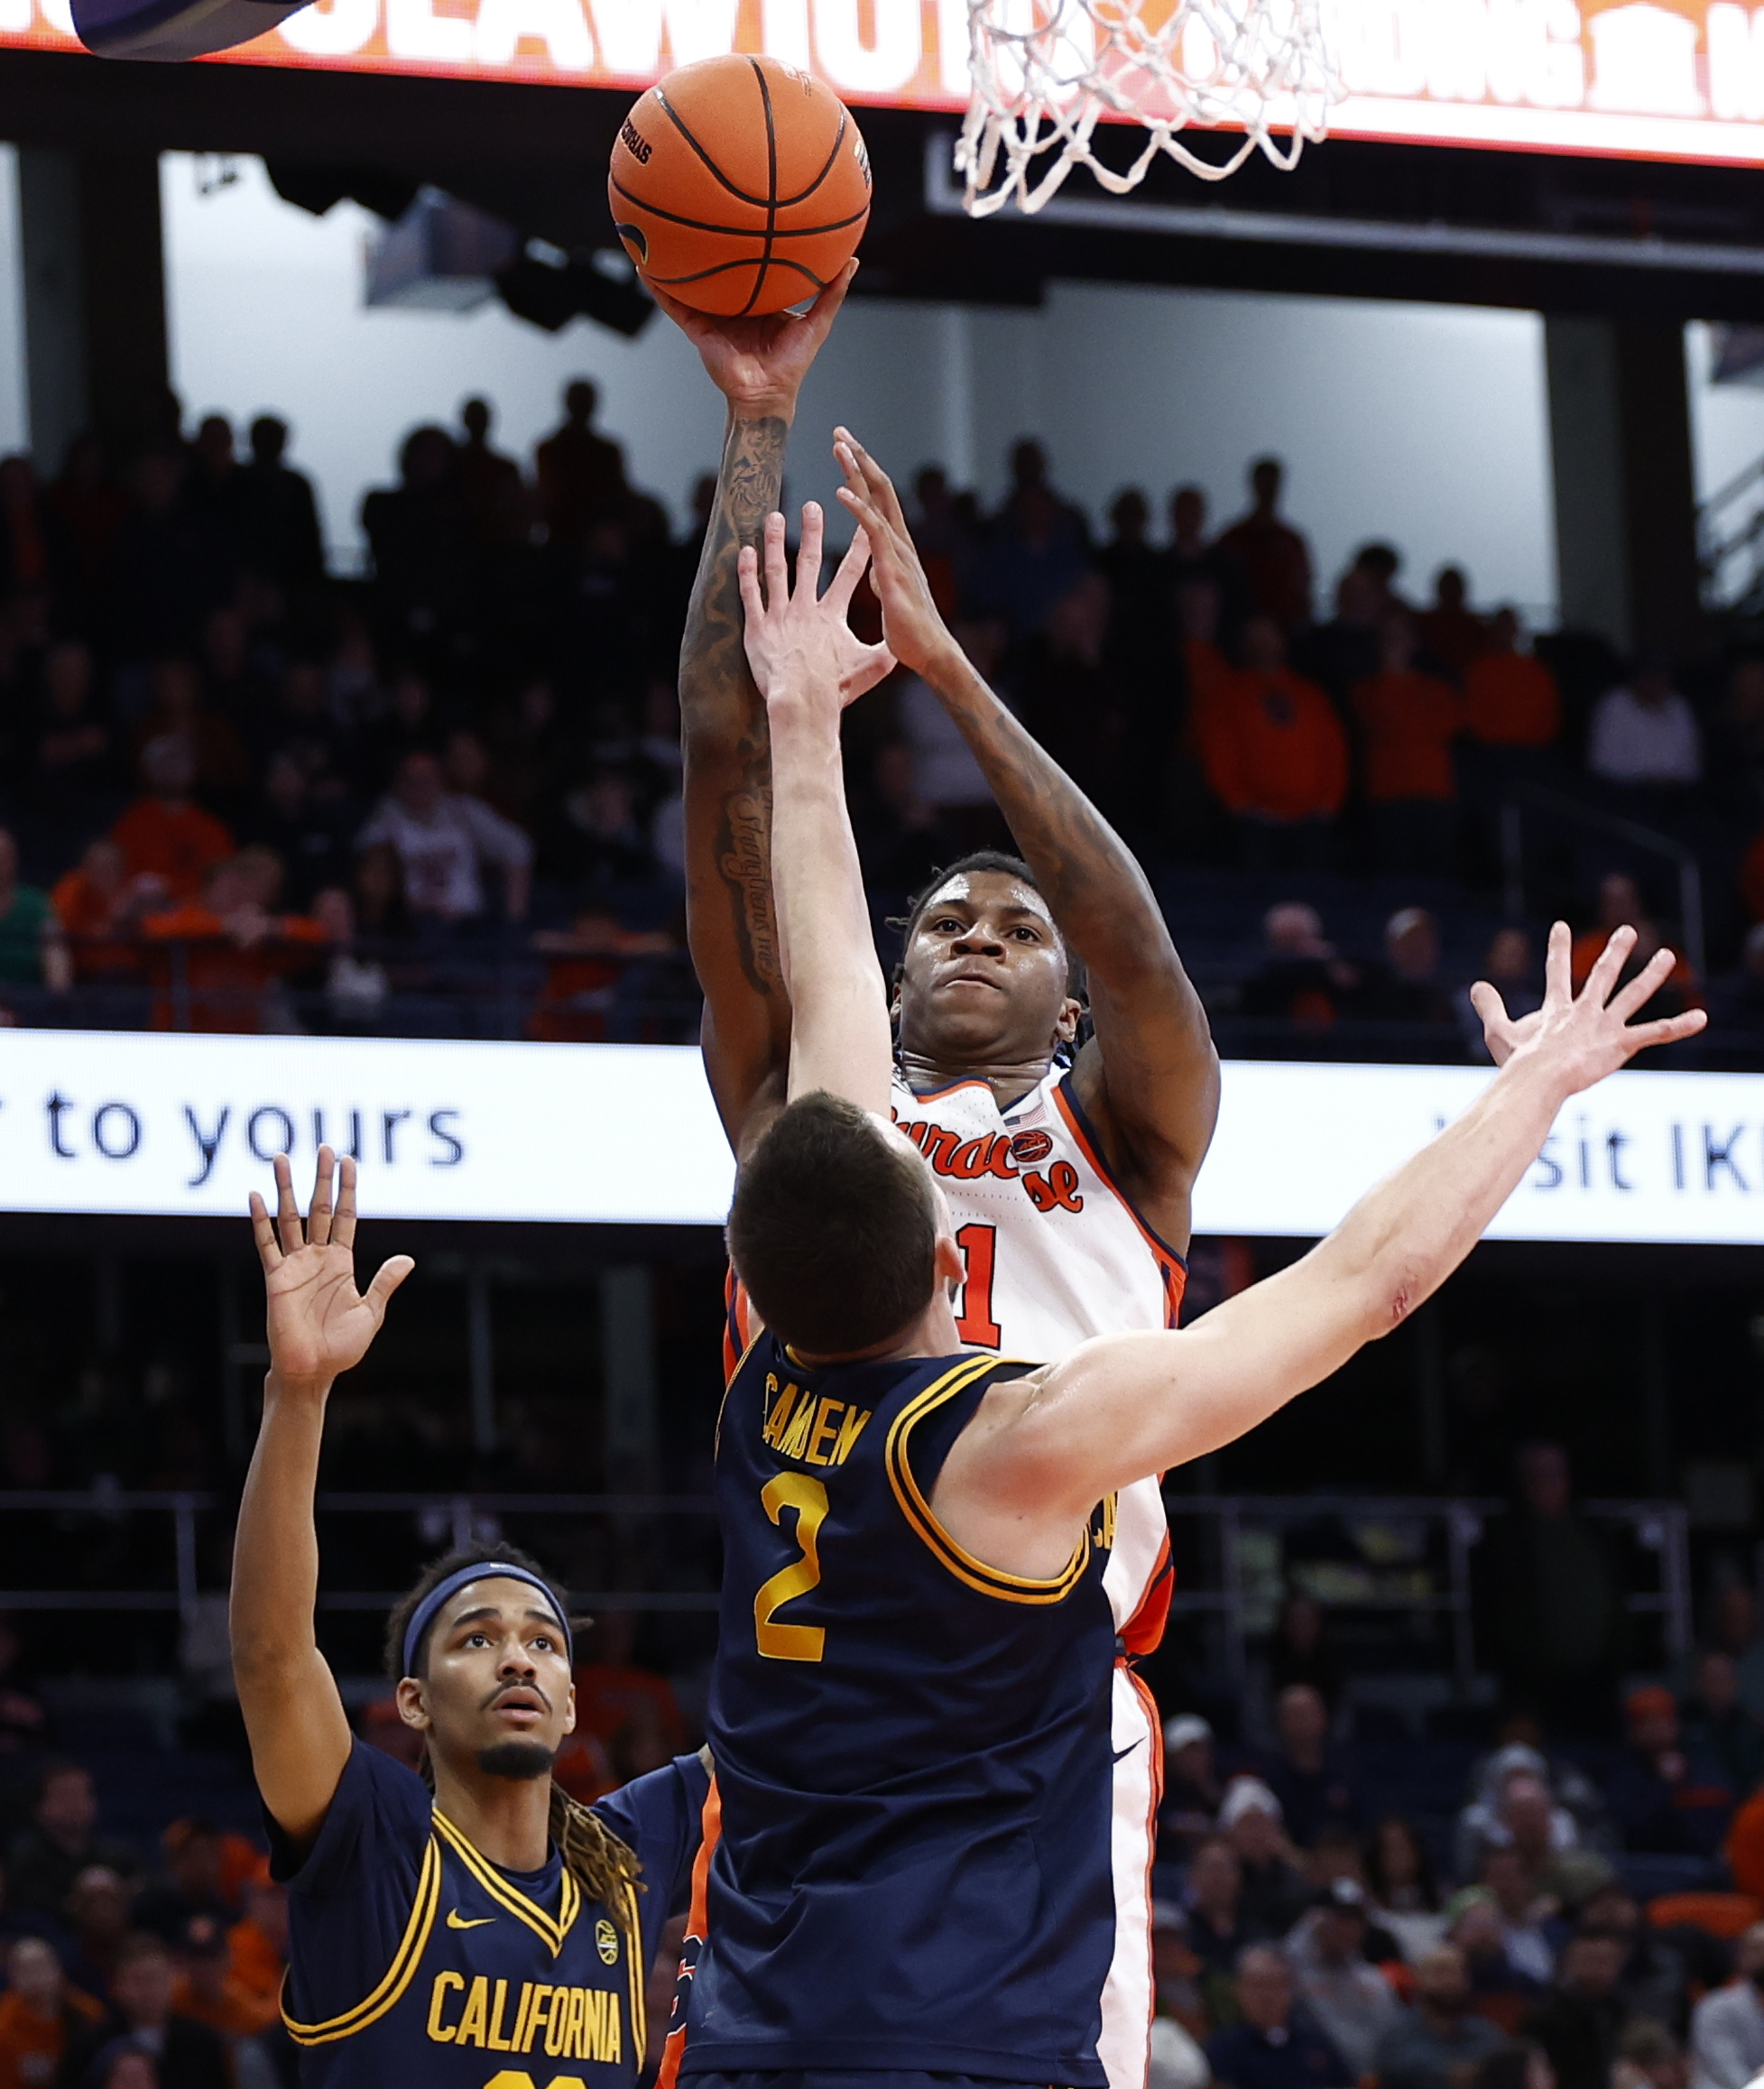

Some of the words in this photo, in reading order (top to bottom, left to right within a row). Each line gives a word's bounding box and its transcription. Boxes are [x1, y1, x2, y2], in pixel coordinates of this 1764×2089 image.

[48, 1088, 142, 1160] to
[184, 1104, 464, 1187] yours
[1672, 1123, 1764, 1191] IK
[753, 1471, 830, 1663] 2
[426, 1970, 623, 2065] CALIFORNIA
